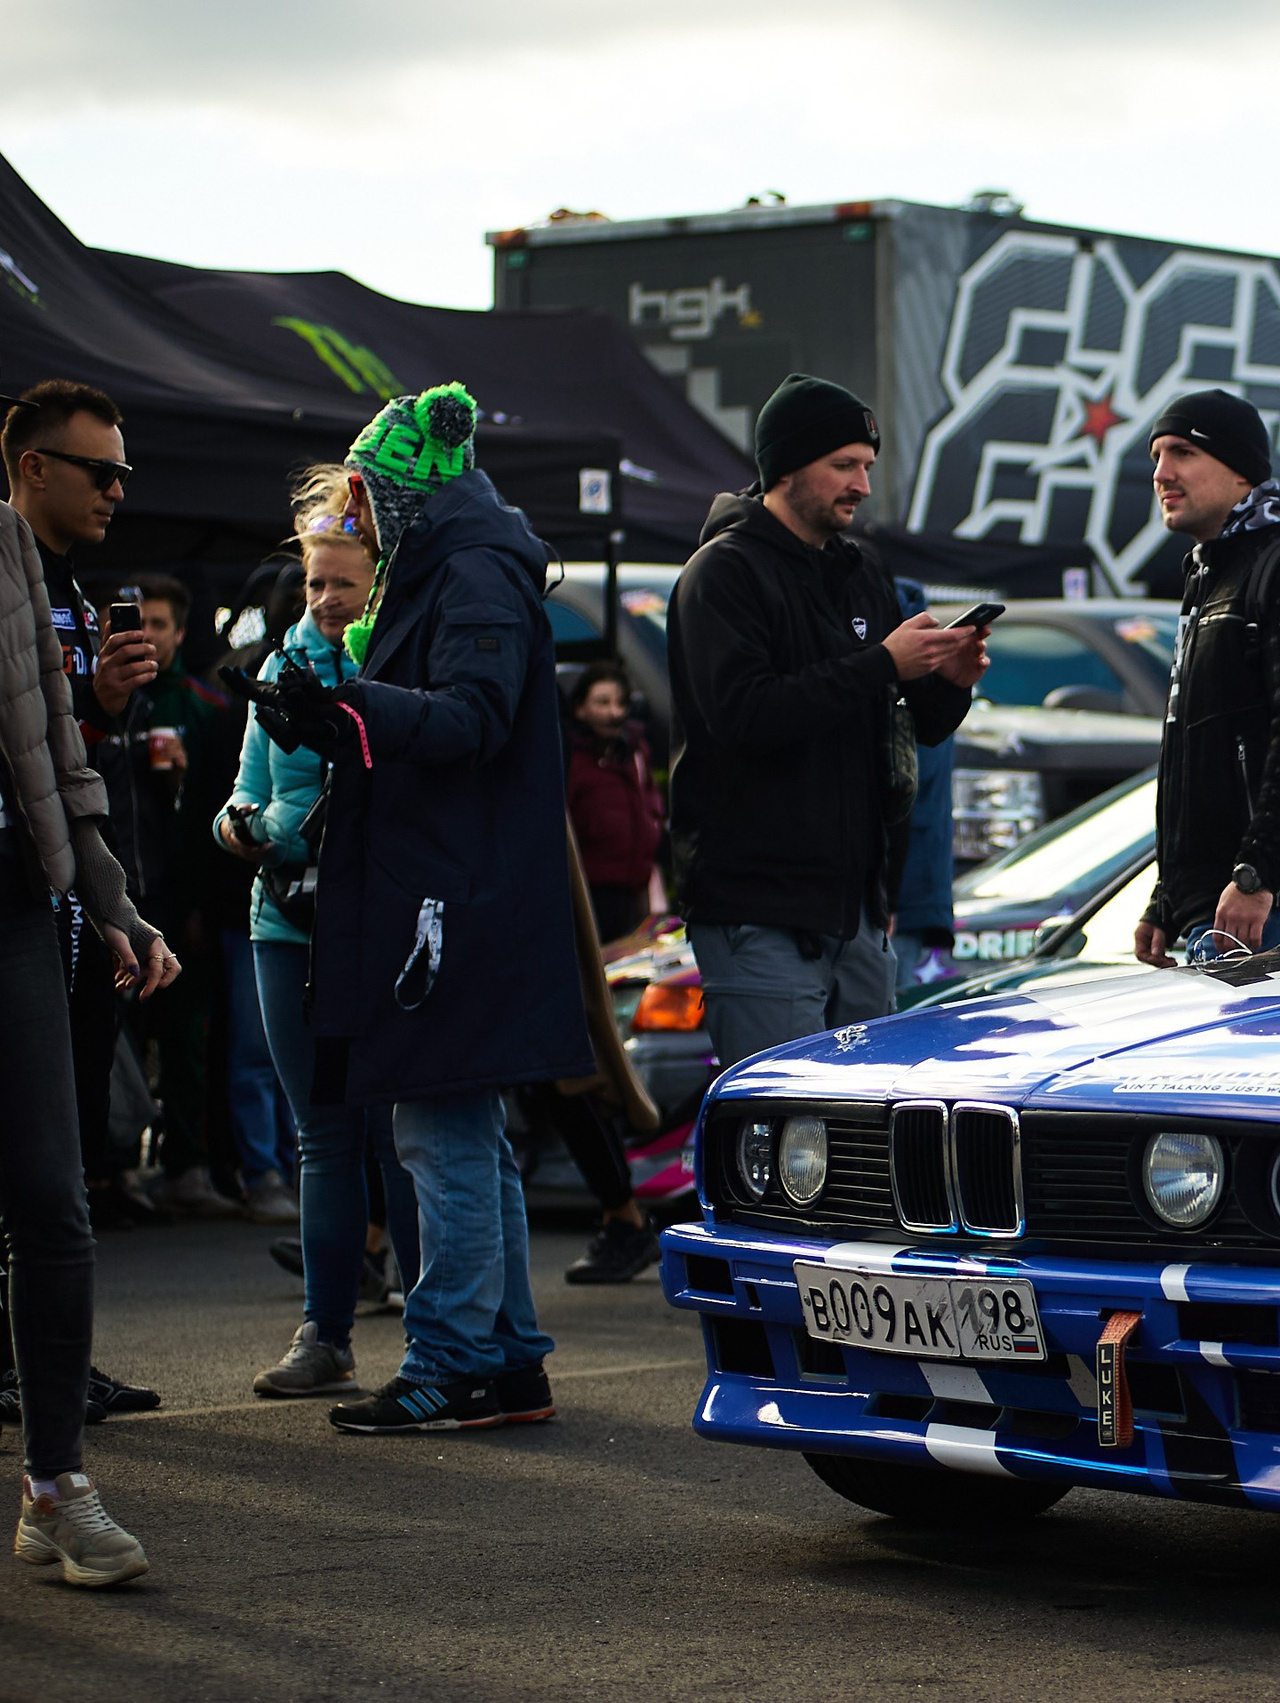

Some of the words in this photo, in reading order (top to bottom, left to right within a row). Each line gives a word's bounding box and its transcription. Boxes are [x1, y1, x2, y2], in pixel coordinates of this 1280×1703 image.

[1118, 1082, 1159, 1091] AIN'T
[1160, 1083, 1222, 1091] TALKING
[957, 1286, 1027, 1334] 198
[978, 1334, 1013, 1352] RUS
[1100, 1348, 1112, 1426] LUKE
